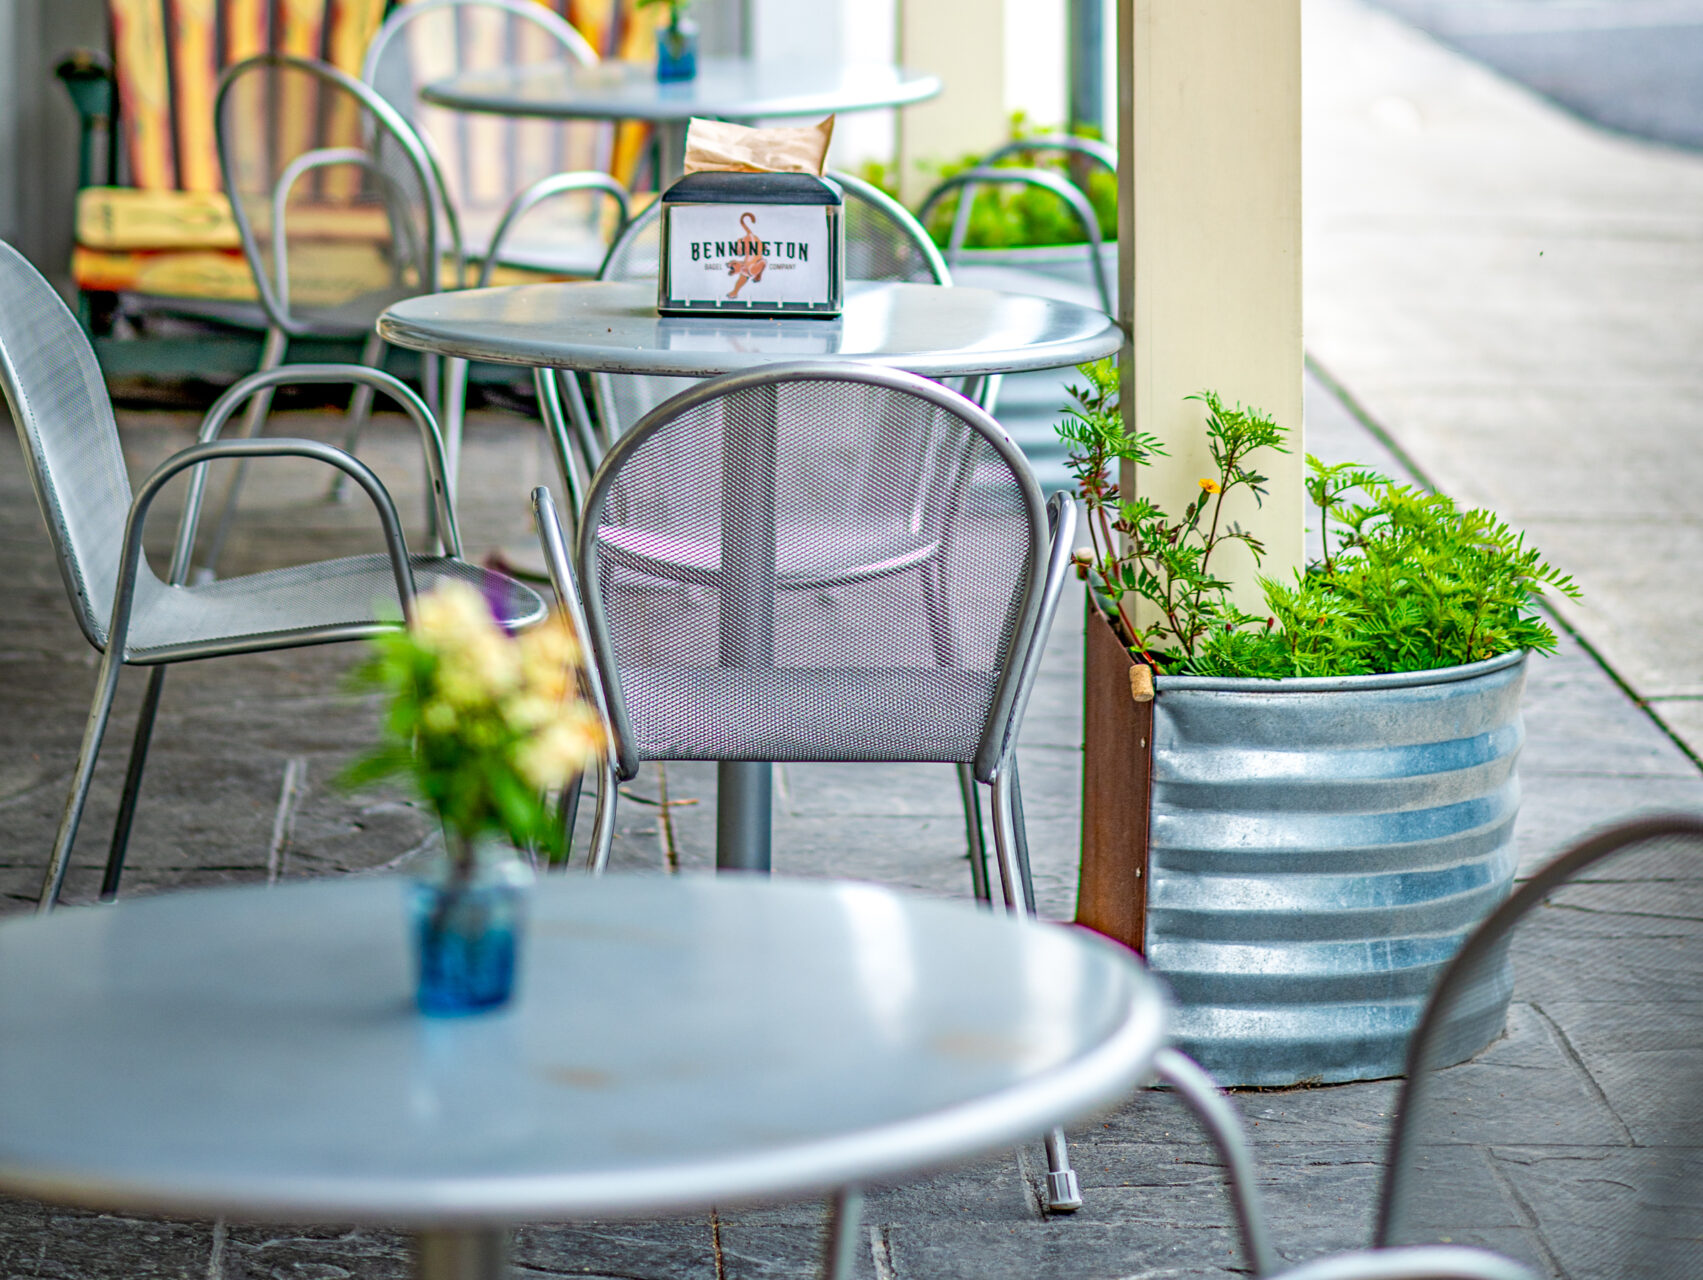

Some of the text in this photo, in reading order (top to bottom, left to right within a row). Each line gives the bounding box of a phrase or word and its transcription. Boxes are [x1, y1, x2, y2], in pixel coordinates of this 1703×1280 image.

[691, 241, 808, 262] BENNINGTON
[704, 263, 796, 271] BAGEL COMPANY
